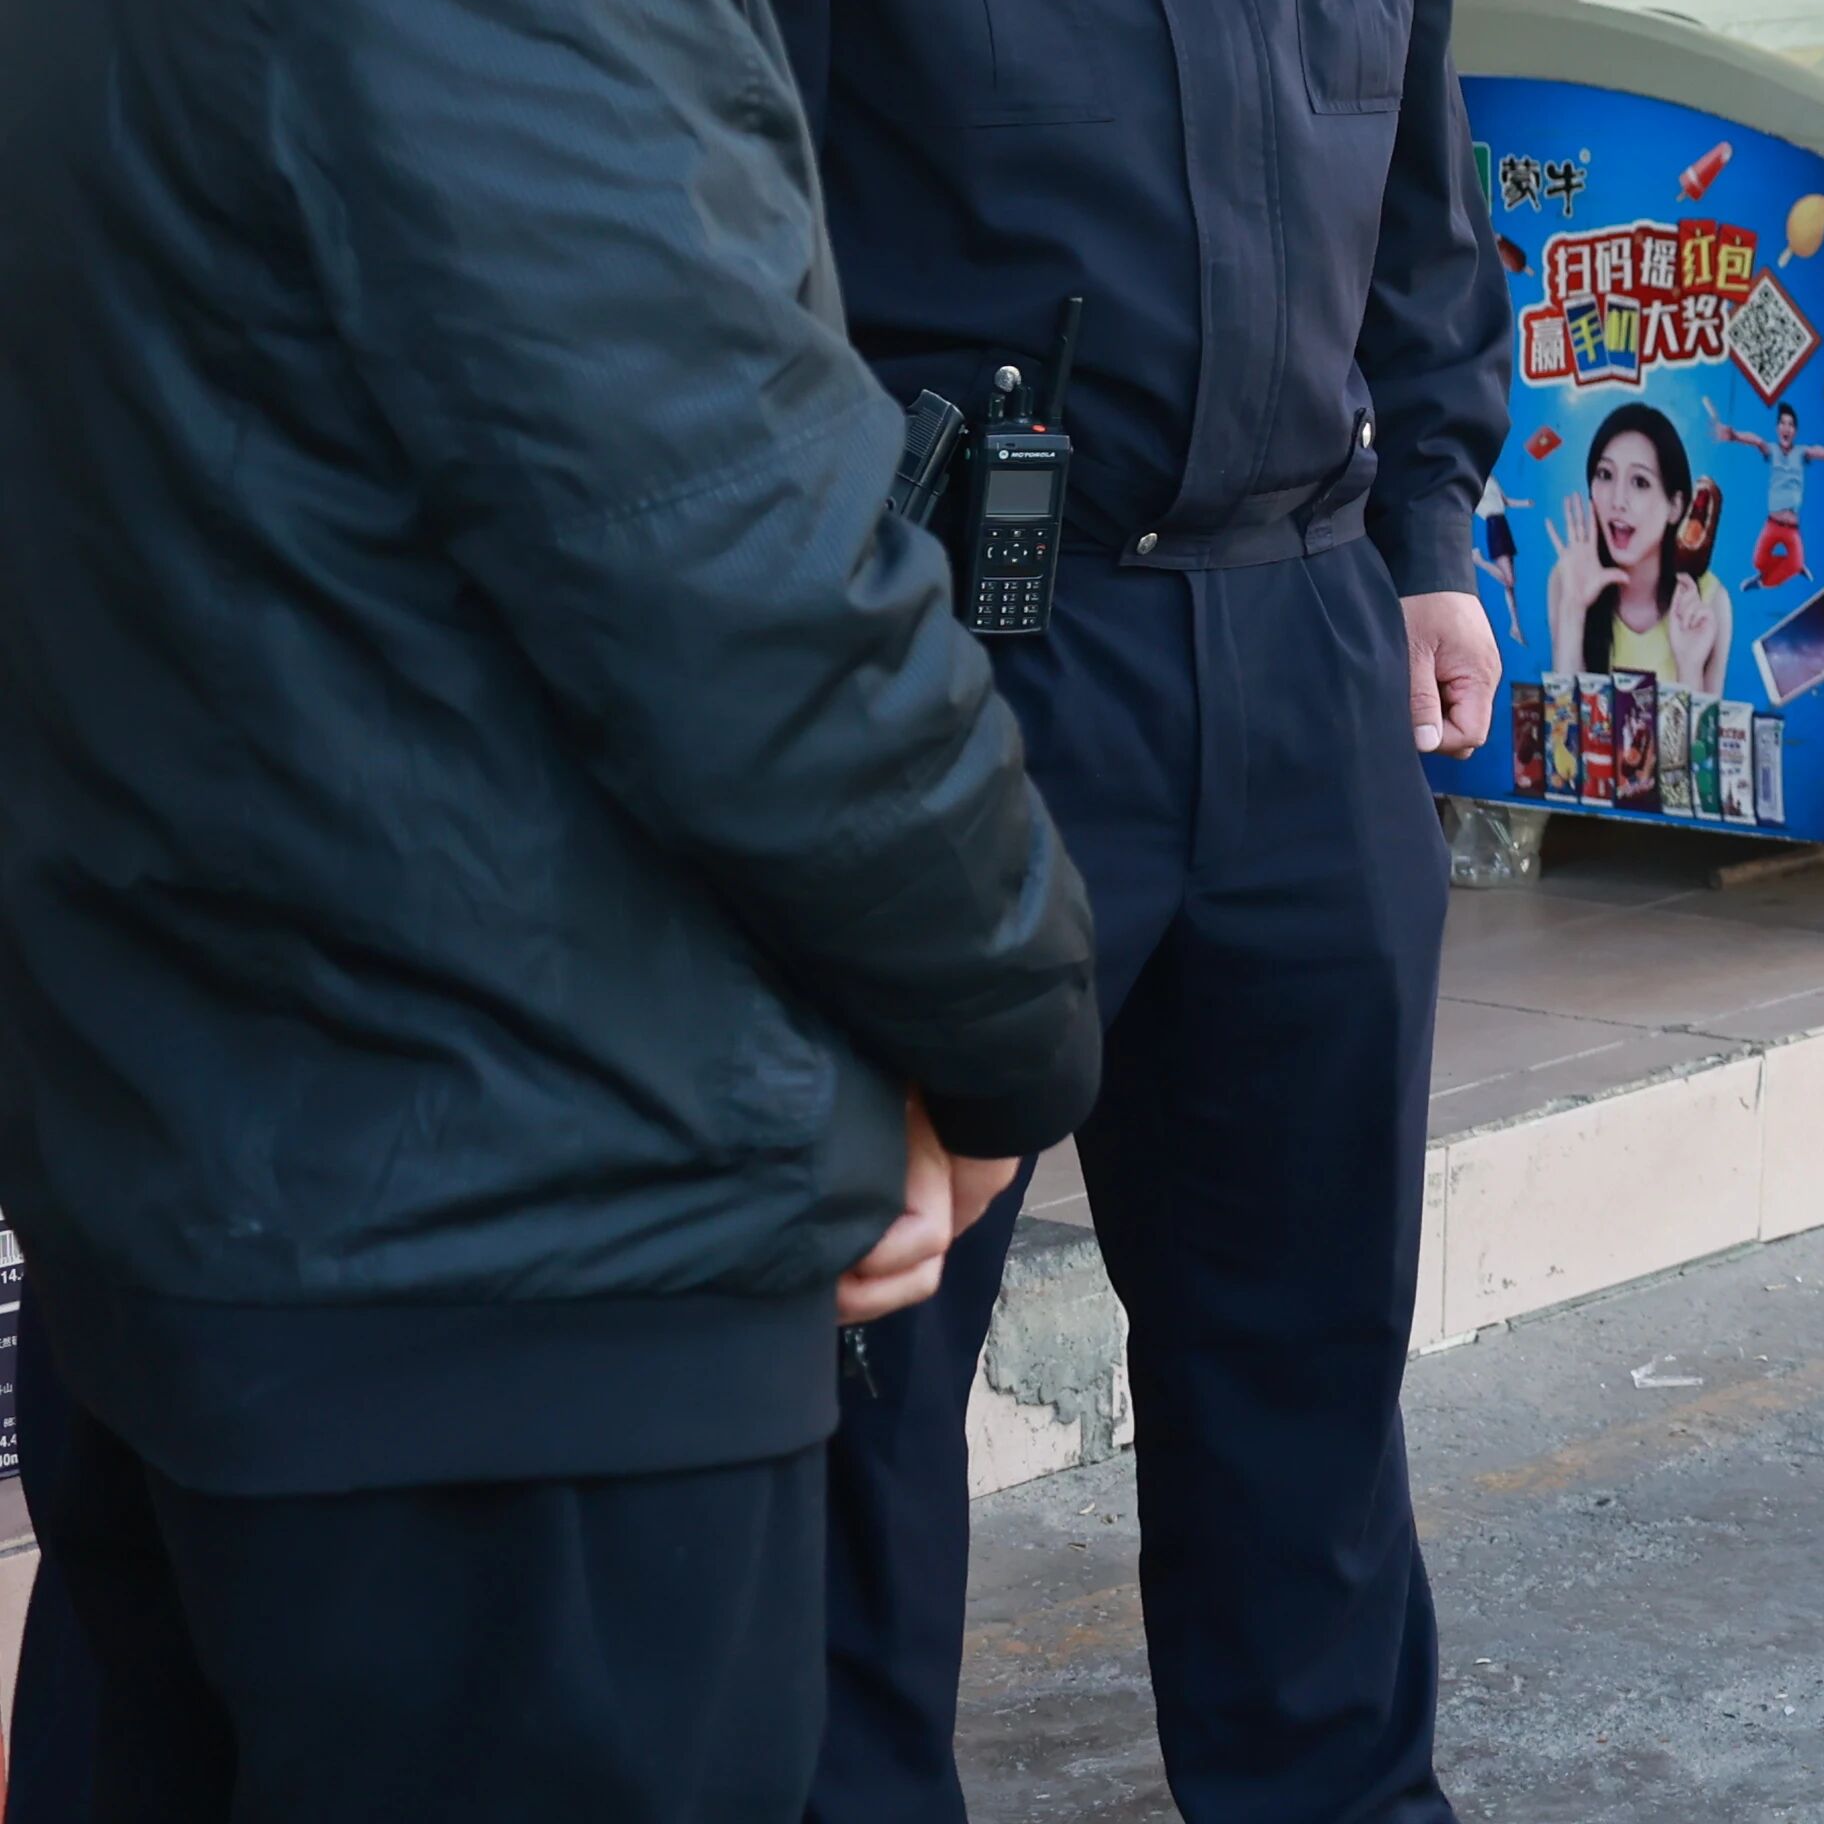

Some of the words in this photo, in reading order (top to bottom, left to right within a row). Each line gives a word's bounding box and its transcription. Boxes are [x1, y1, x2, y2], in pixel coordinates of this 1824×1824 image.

[1501, 156, 1585, 216] 蒙牛
[1555, 229, 1754, 299] 扫码摇红包
[1530, 295, 1720, 374] 赢手机大奖
